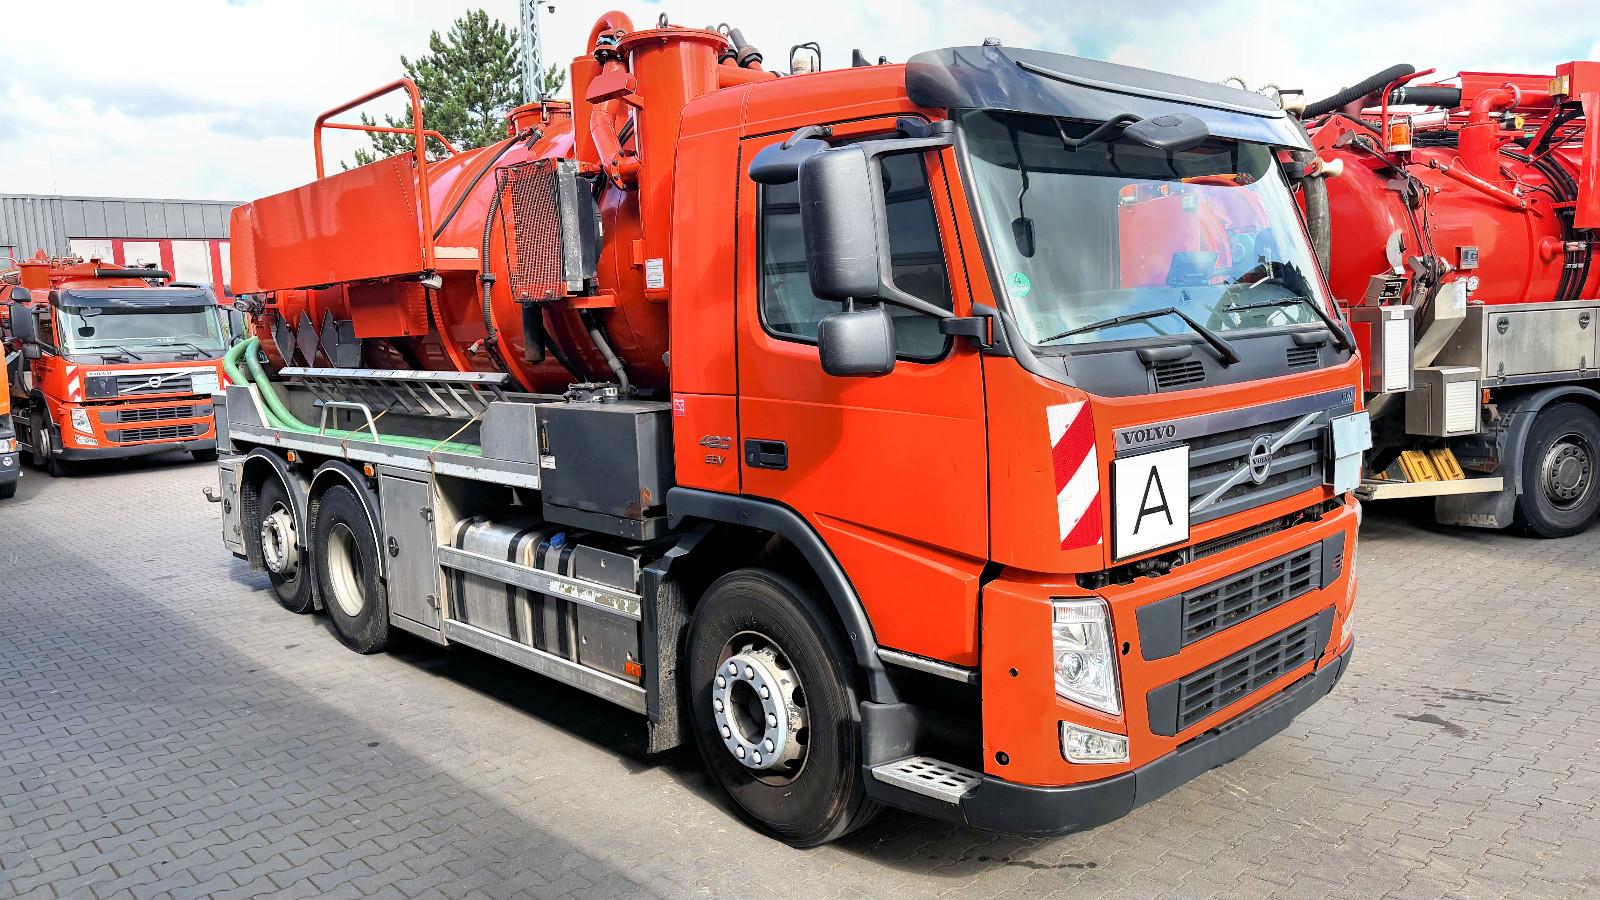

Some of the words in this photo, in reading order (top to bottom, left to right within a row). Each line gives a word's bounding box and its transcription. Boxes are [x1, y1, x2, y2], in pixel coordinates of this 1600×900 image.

[699, 435, 732, 449] 420
[1121, 424, 1176, 444] VOLVO
[1133, 465, 1173, 535] A
[1448, 513, 1498, 527] CANIA
